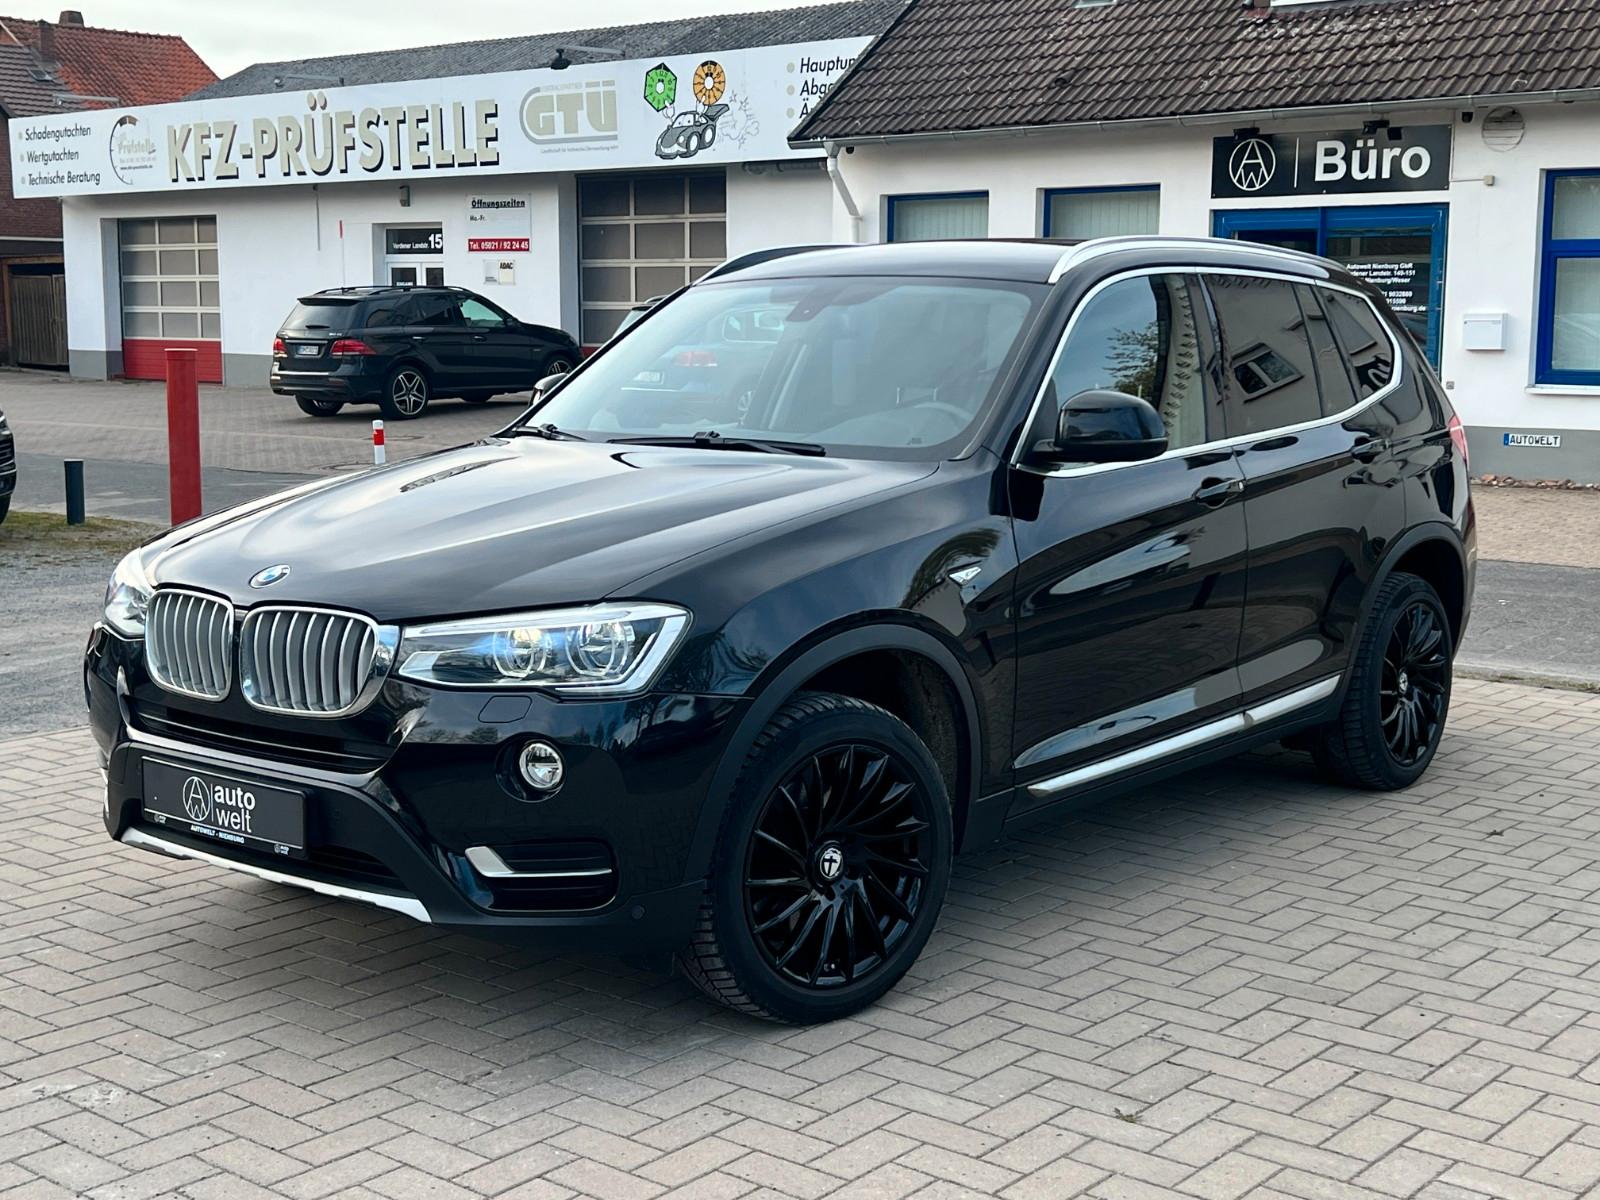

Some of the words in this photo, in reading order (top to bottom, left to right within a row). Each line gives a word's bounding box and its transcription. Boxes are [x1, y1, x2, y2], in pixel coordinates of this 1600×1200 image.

[526, 80, 618, 135] GTÜ
[25, 123, 91, 143] Schadengutachten
[167, 92, 500, 182] KFZ-PRÜFSTELLE
[27, 147, 79, 166] Wertgutachten
[1314, 138, 1431, 182] Büro
[28, 171, 65, 186] Technische
[67, 171, 101, 186] Beratung
[471, 197, 526, 210] Öffnungszeiten
[429, 233, 443, 249] 15
[469, 241, 480, 250] Tel.
[481, 241, 498, 250] 05021
[503, 241, 511, 250] 92
[512, 241, 519, 250] 24
[521, 241, 529, 250] 45
[1509, 434, 1559, 446] AUTOWELT
[214, 784, 256, 811] auto
[190, 824, 216, 836] AUTOWELT
[216, 808, 252, 833] welt
